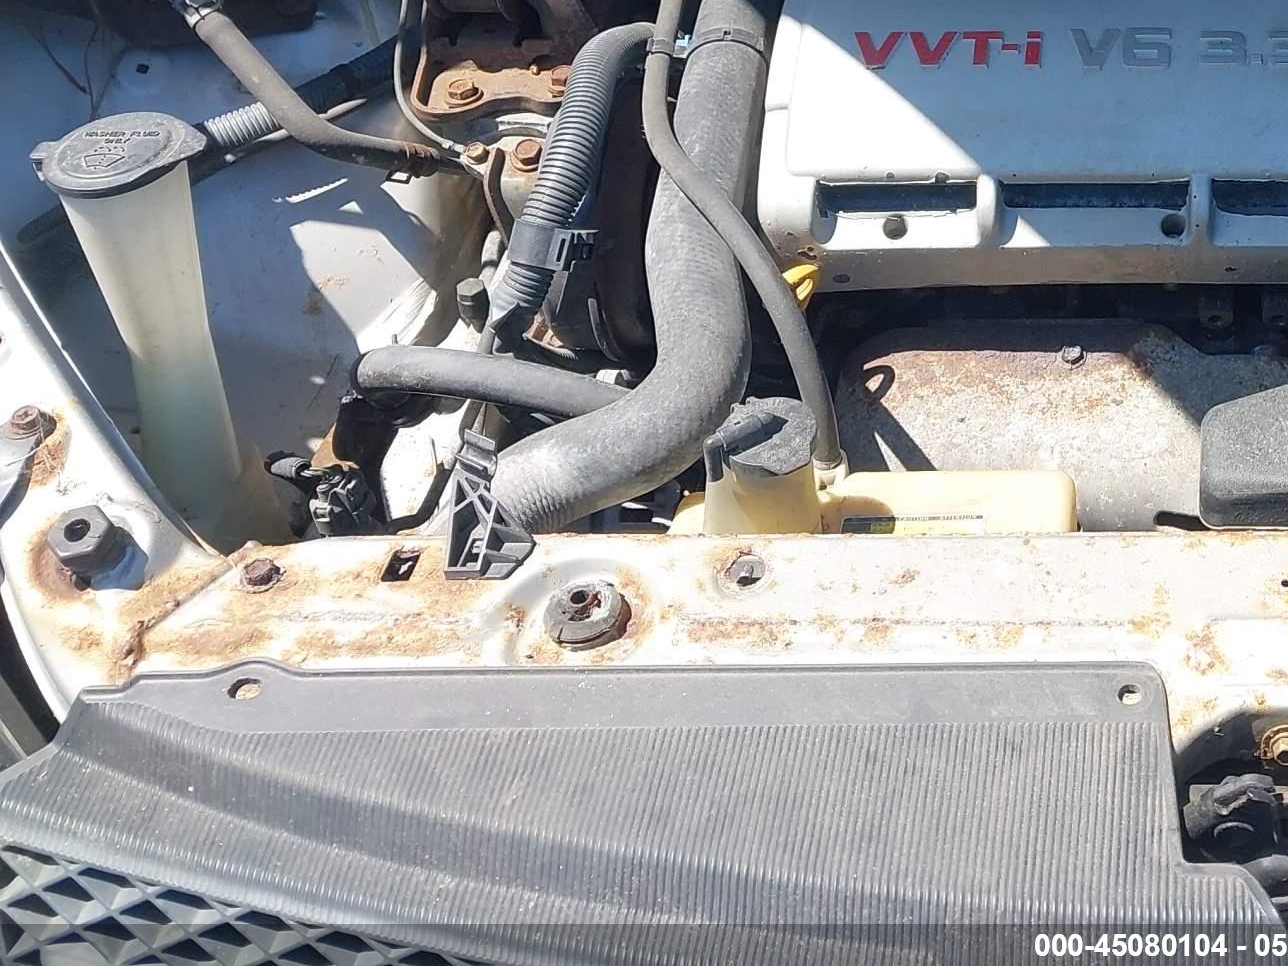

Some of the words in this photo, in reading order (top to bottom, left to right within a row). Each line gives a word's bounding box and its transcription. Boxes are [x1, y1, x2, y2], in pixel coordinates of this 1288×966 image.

[854, 30, 1045, 69] VVT-i
[1070, 28, 1174, 68] V6
[85, 130, 126, 138] WASHER
[130, 130, 160, 138] FLUID
